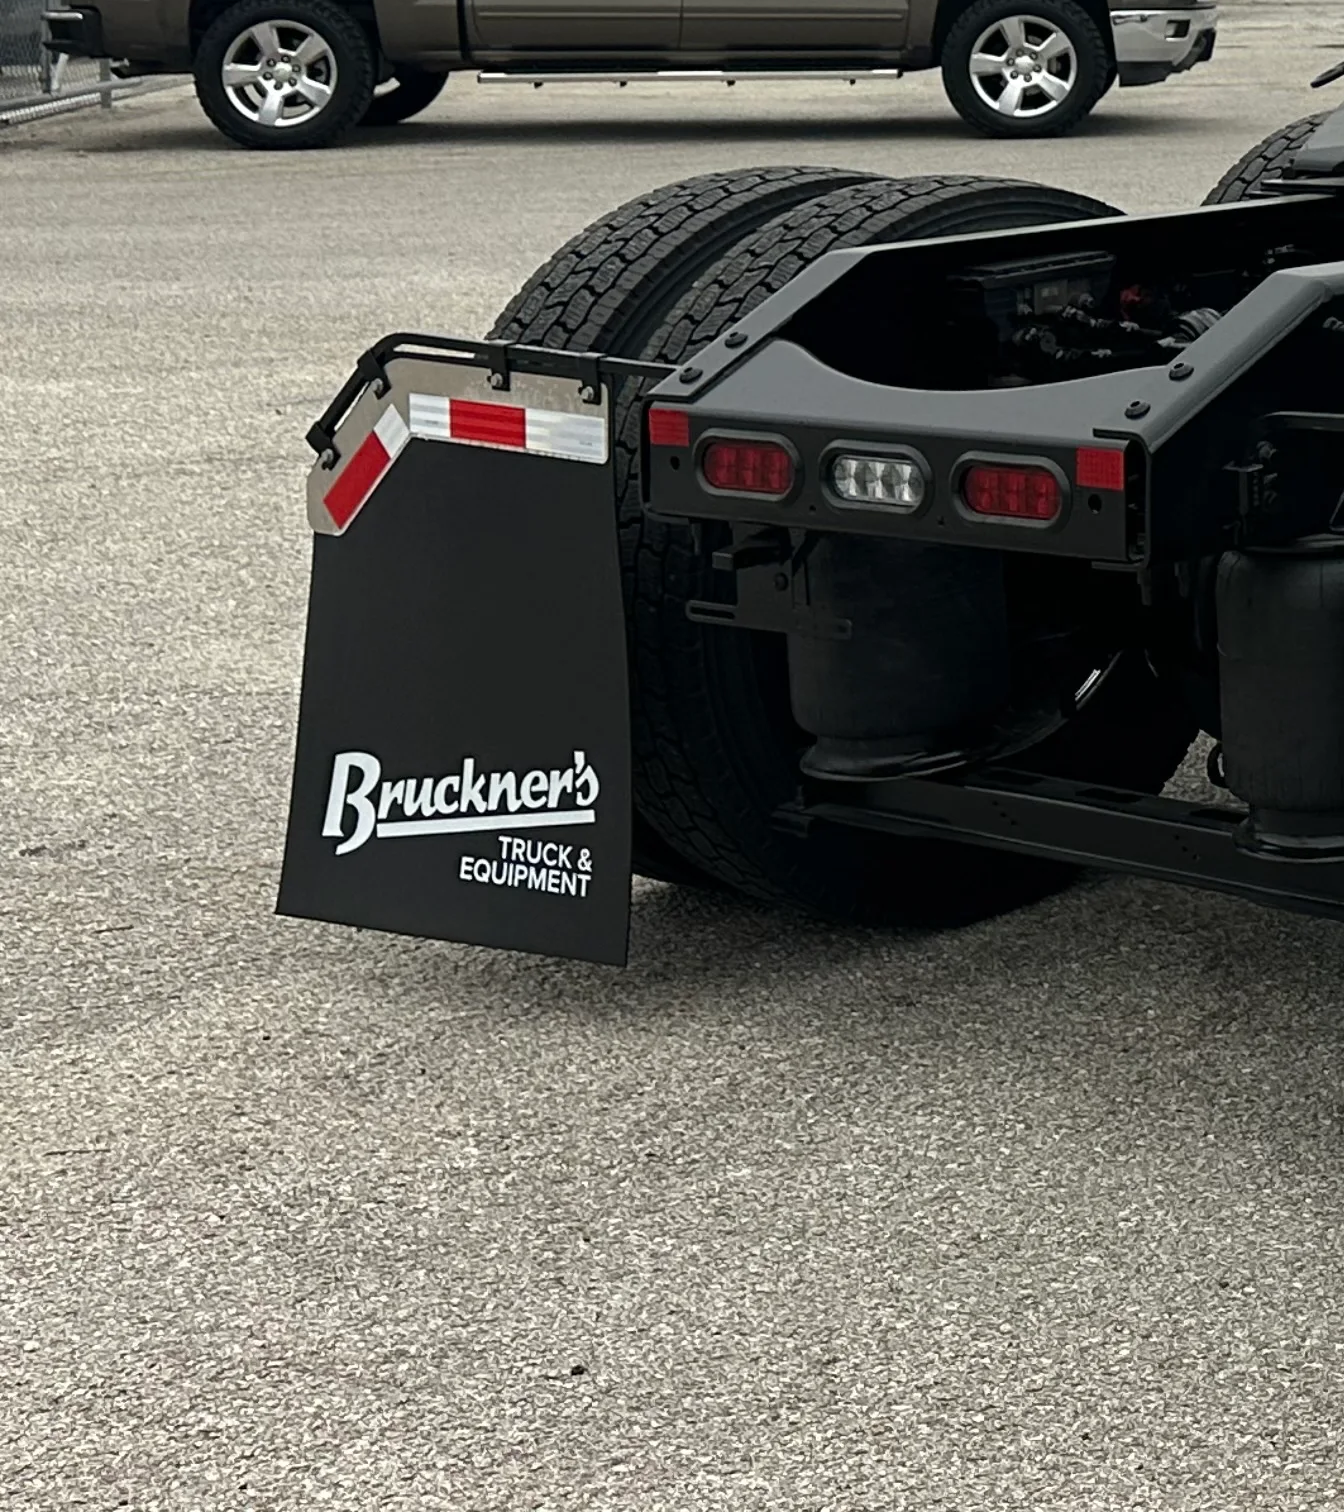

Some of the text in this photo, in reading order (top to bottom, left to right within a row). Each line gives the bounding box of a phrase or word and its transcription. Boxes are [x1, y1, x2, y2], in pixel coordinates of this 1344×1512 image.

[321, 750, 600, 856] Bruckner's
[498, 835, 593, 873] TRUCK &
[459, 856, 592, 897] EQUIPMENT
